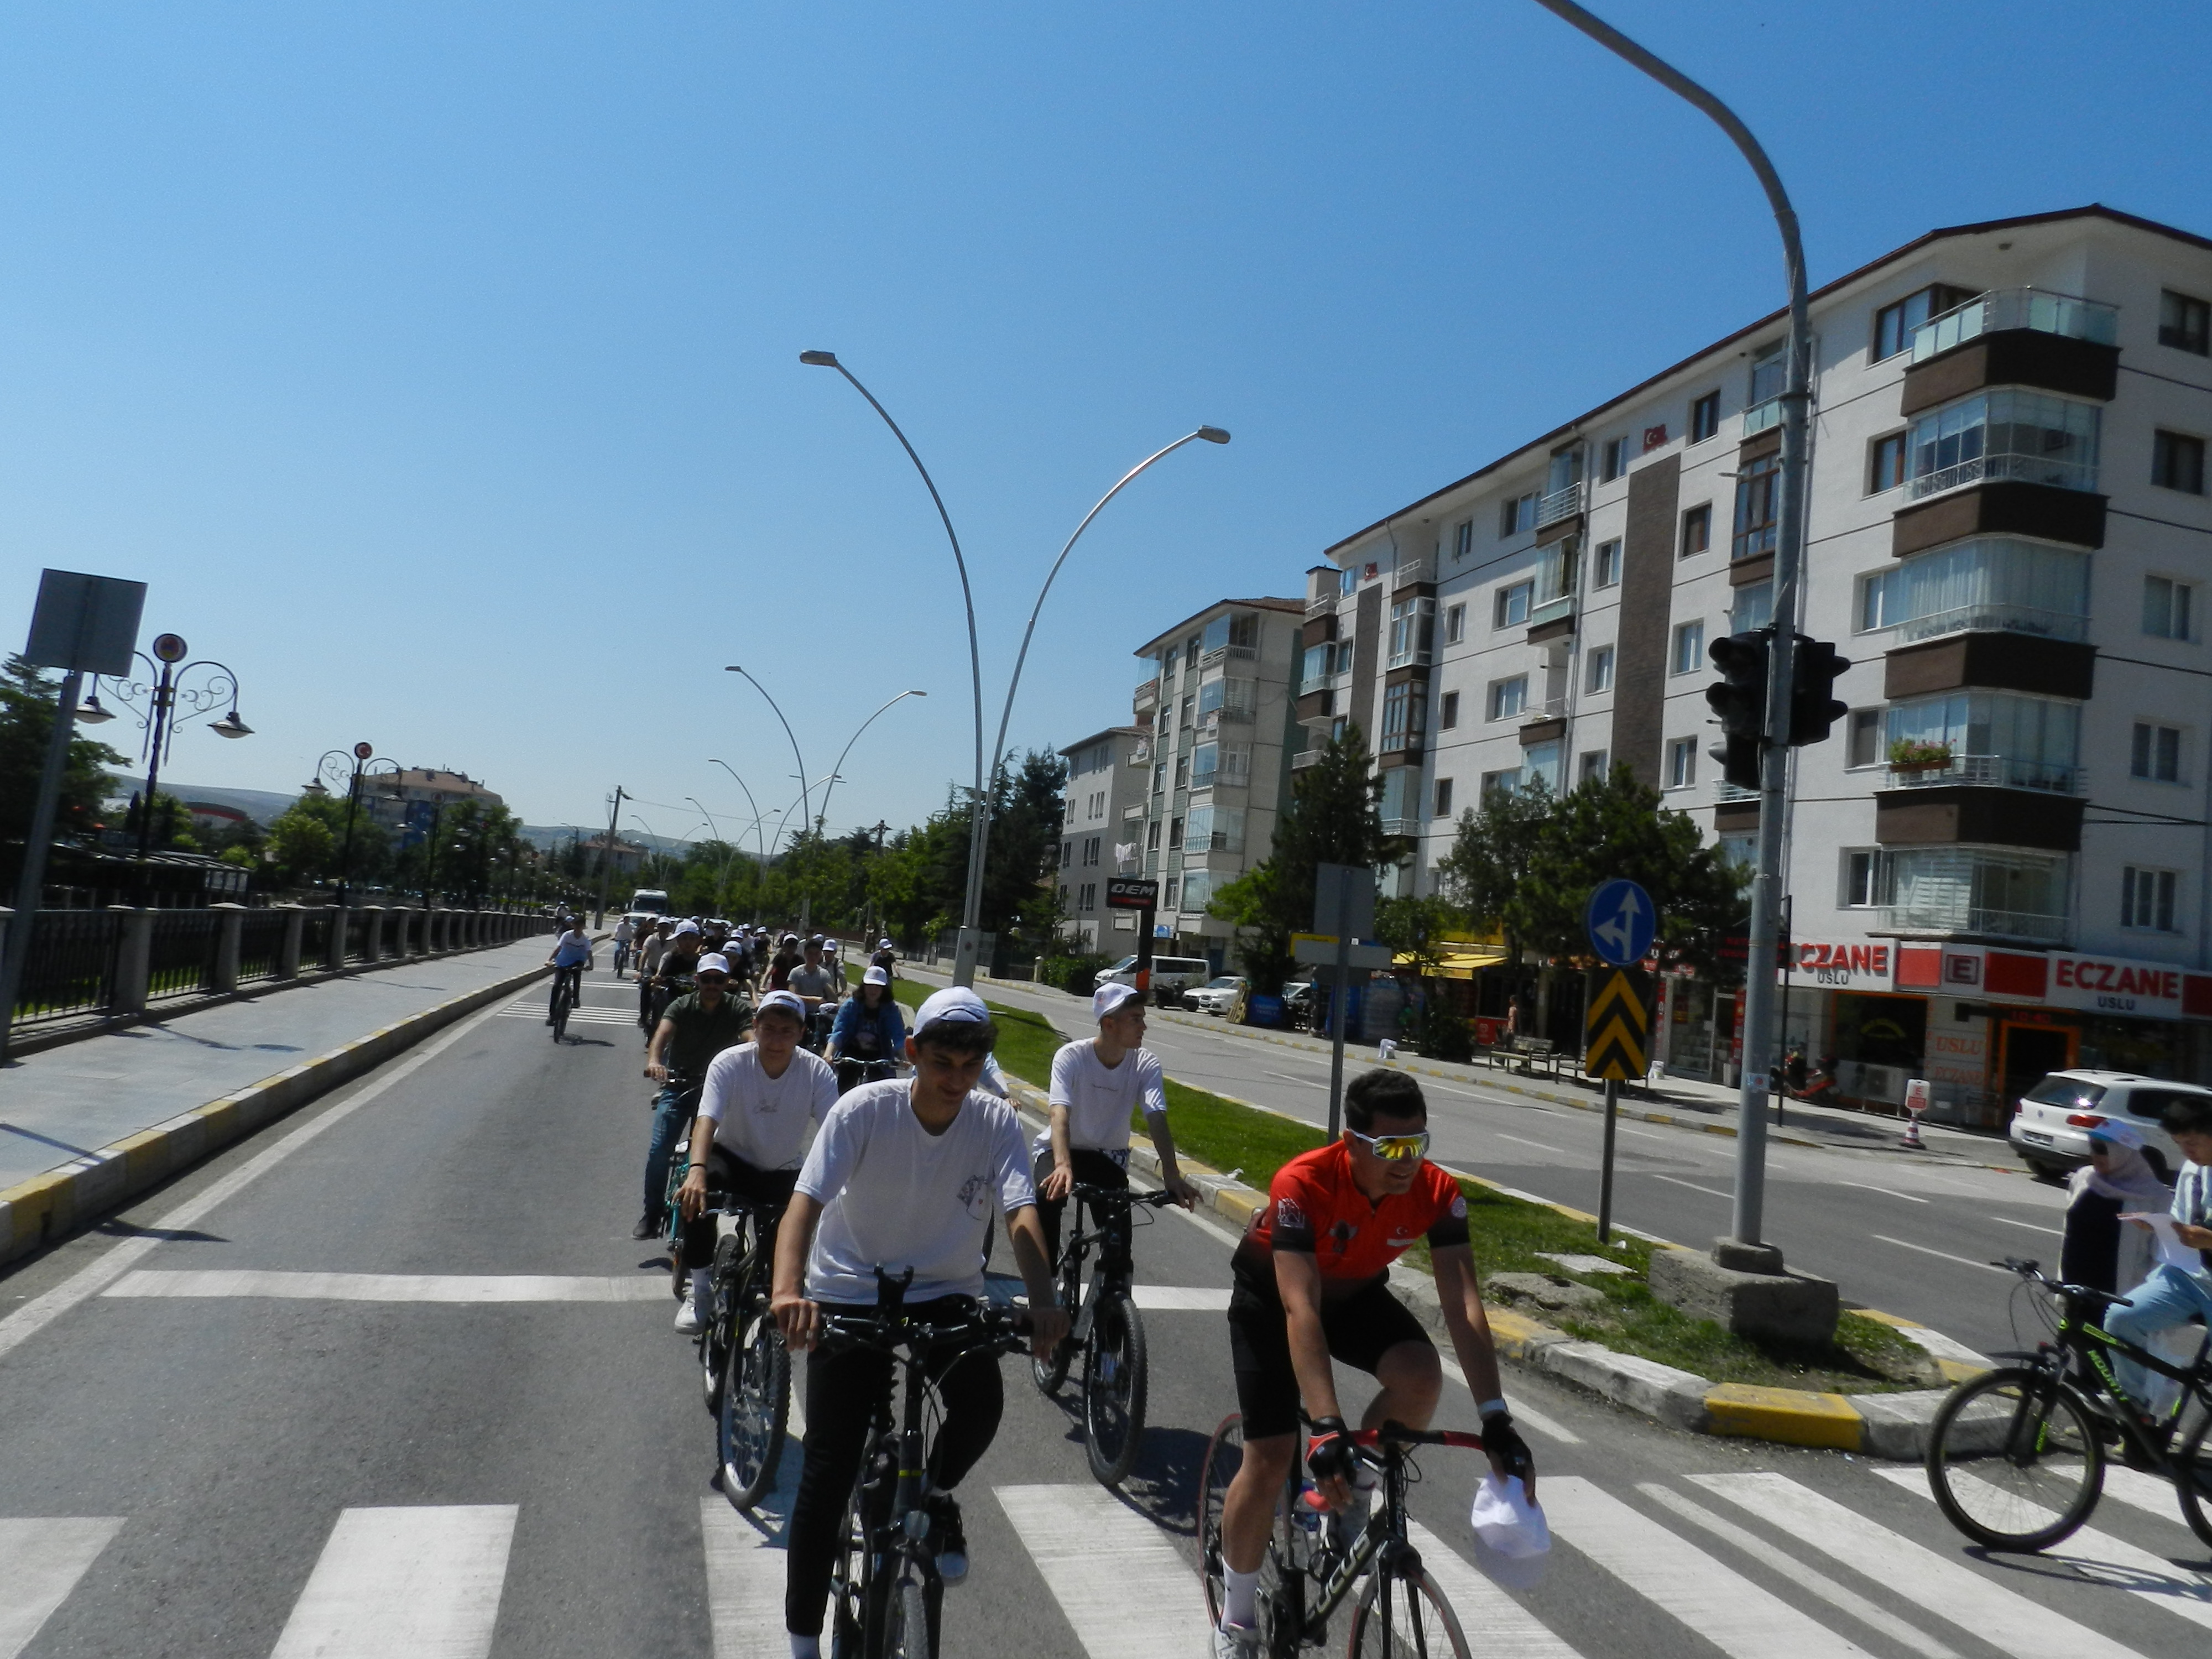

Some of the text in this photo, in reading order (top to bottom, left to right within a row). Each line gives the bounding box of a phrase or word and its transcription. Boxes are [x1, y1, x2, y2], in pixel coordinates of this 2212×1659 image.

[1788, 942, 1888, 971] CZANE
[1952, 958, 1972, 979] E
[2056, 958, 2179, 999] ECZANE
[1818, 973, 1849, 985] USLU
[2098, 996, 2136, 1011] USLU
[1936, 1036, 1983, 1055] USLU
